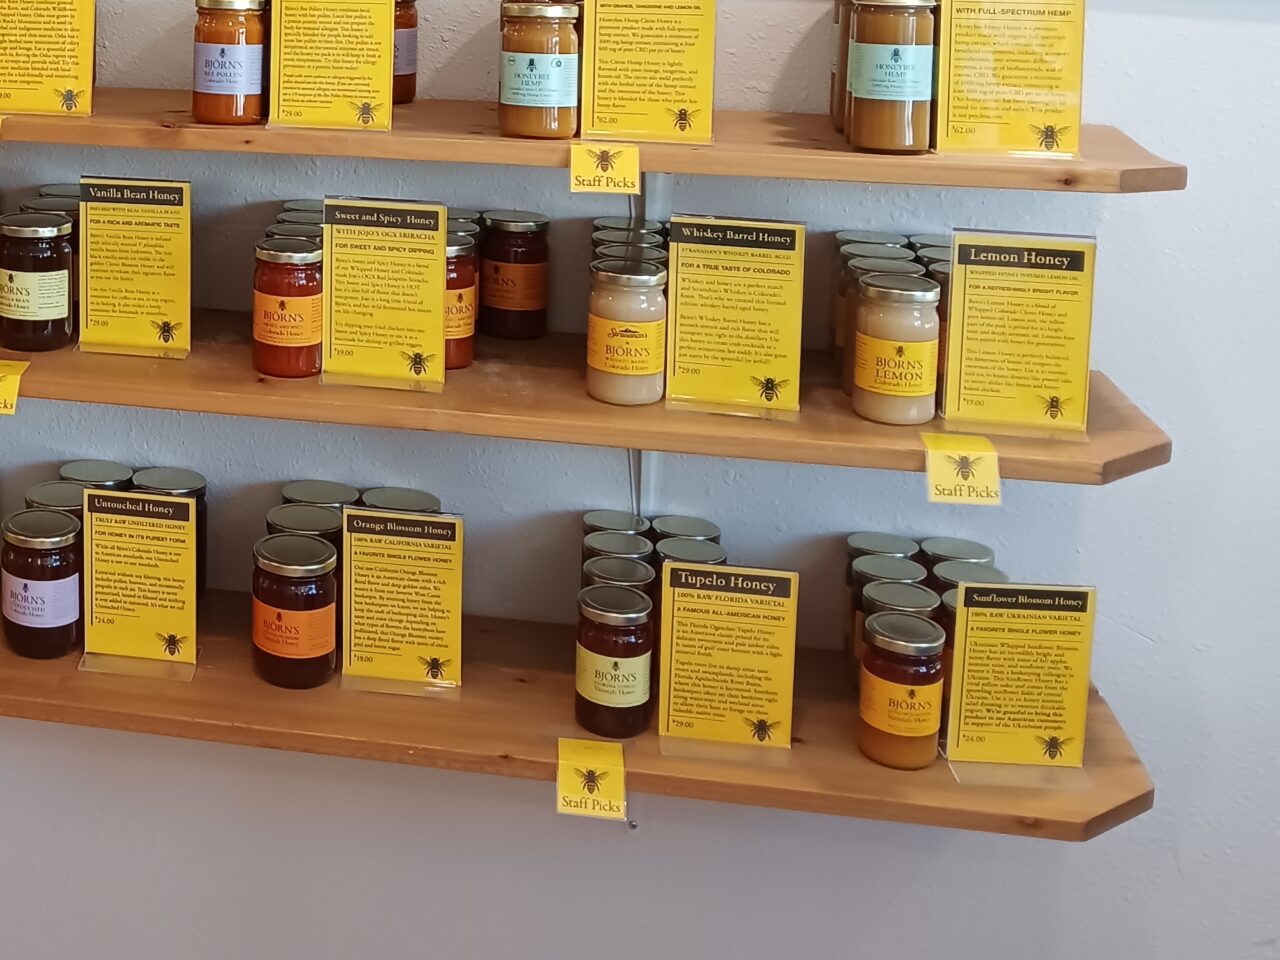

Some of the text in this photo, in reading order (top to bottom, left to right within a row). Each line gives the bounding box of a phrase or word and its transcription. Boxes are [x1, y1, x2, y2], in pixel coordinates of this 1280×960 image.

[977, 7, 1046, 16] FULL-SPECTRUM
[1047, 9, 1072, 17] HEMP
[574, 174, 636, 189] Staff Picks
[89, 187, 181, 204] Vanilla Bean Honey
[334, 210, 436, 228] Sweet and Spicy Honey
[681, 227, 792, 246] Whiskey Barrel Honey
[970, 248, 1070, 269] Lemon Honey
[701, 263, 720, 271] TRUE
[752, 267, 791, 276] COLORADO
[875, 369, 923, 382] LEMON
[934, 483, 1000, 499] Staff Picks
[94, 498, 174, 516] Untouched Honey
[353, 519, 452, 537] Orange Blossom Honey
[678, 571, 777, 595] Tupelo Honey
[972, 593, 1084, 608] Sunflower Blossom Honey
[561, 795, 621, 813] Staff Picks
